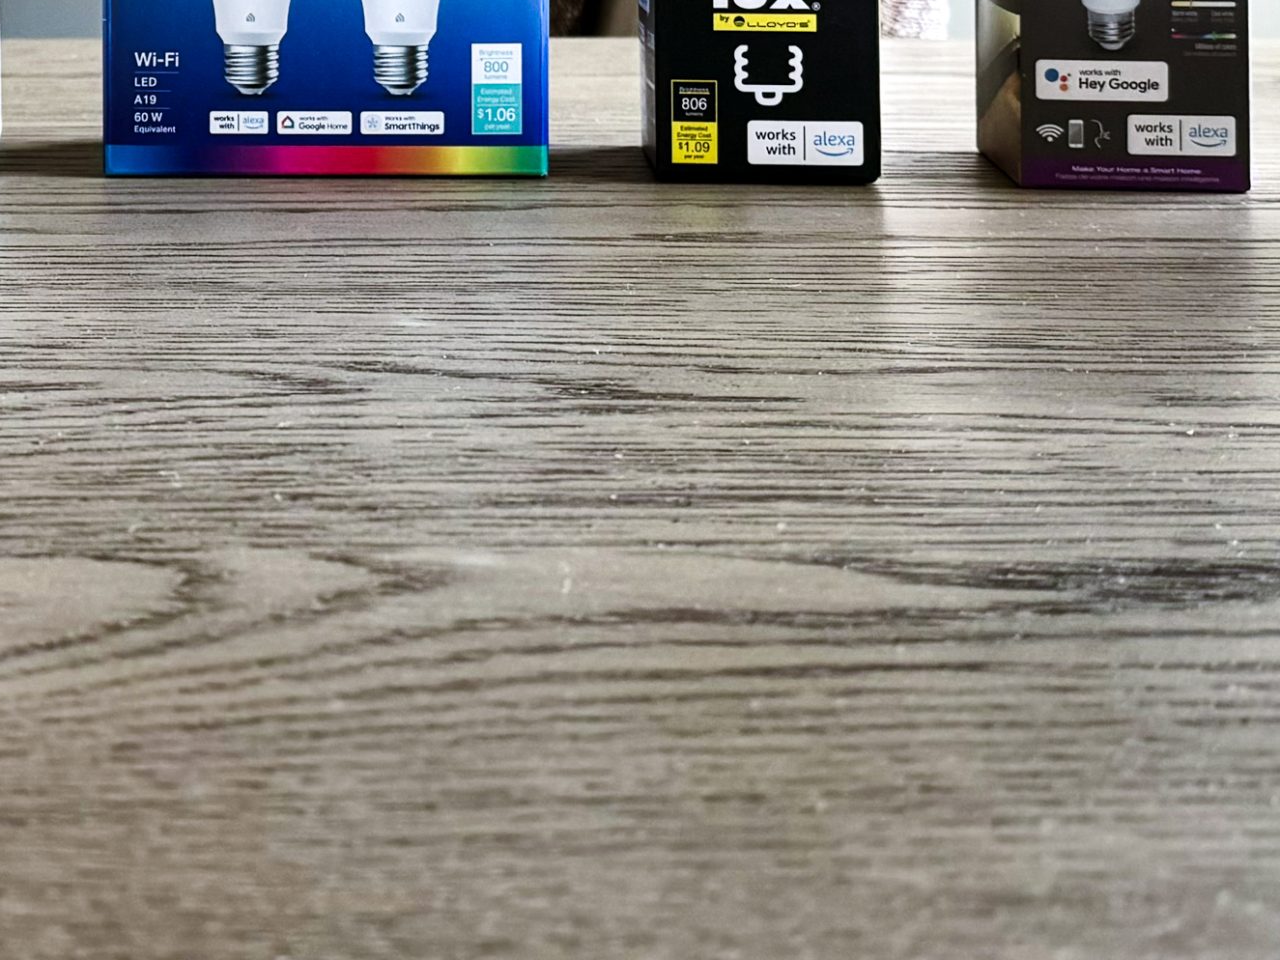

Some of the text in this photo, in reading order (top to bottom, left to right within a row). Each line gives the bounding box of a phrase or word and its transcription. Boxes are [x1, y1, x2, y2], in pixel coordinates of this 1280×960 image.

[720, 14, 729, 23] by
[134, 52, 179, 67] Wi-Fi
[484, 61, 509, 72] 800
[134, 77, 157, 87] LED
[1079, 78, 1159, 93] Hey Google
[134, 95, 157, 105] A19
[681, 97, 707, 110] 806
[134, 113, 162, 122] 60 W
[477, 108, 516, 122] $1.06
[134, 125, 176, 134] Equivalent
[299, 122, 325, 132] Google
[385, 122, 440, 133] SmartThings
[1135, 122, 1173, 133] works
[1188, 125, 1228, 138] alexa
[755, 130, 796, 141] works
[813, 131, 855, 146] alexa
[678, 141, 710, 153] $1.09
[1145, 136, 1172, 147] with
[766, 144, 796, 156] with
